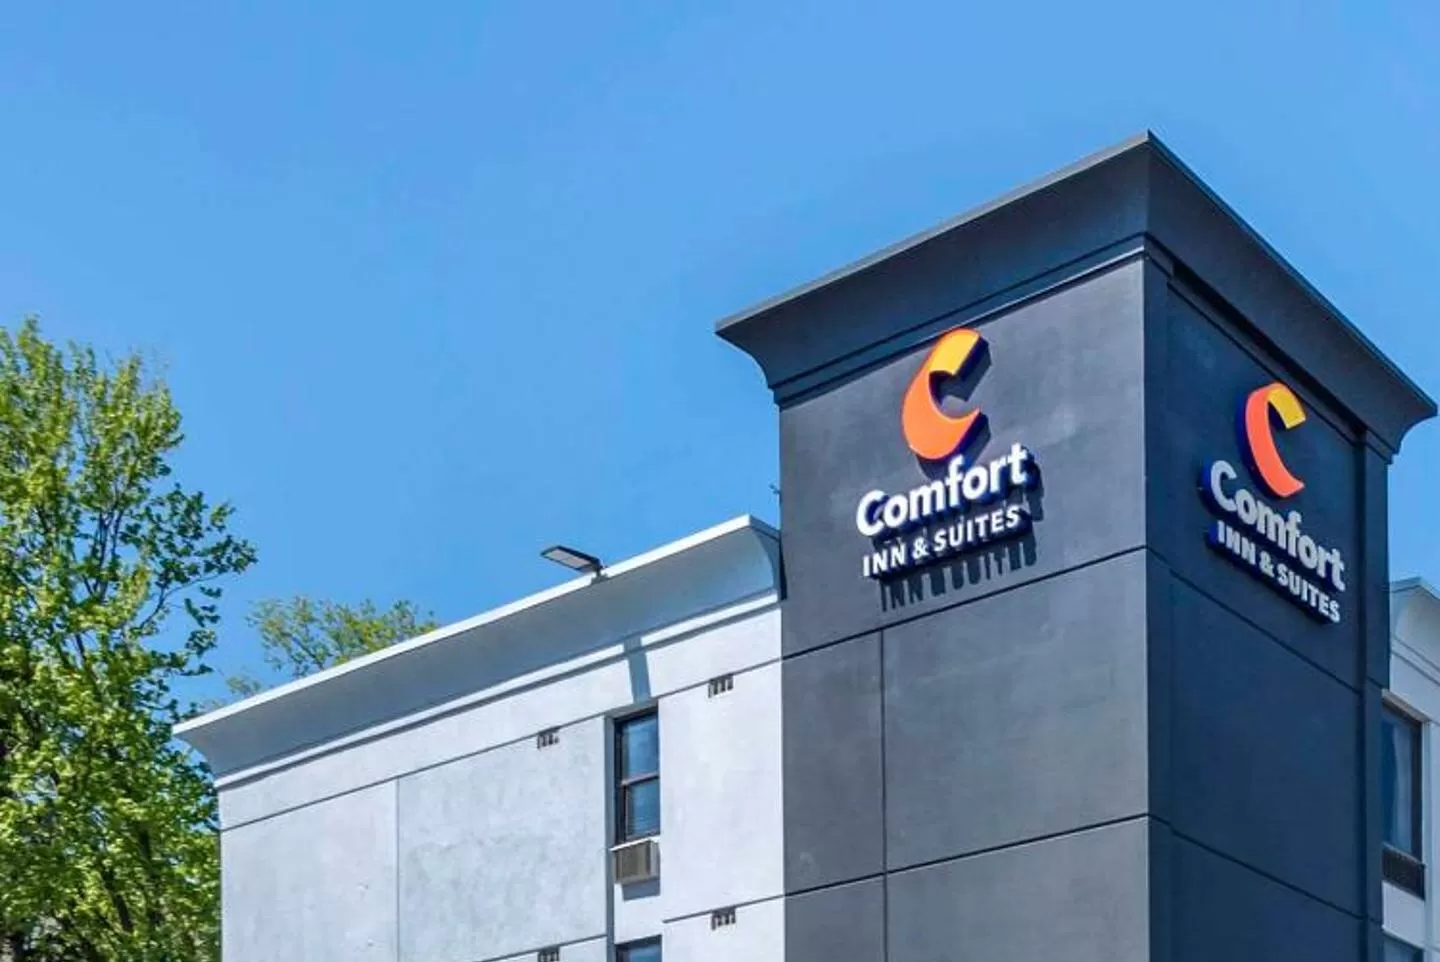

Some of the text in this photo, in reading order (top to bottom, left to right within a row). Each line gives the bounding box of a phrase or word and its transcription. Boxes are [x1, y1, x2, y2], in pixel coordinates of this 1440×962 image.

[856, 443, 1027, 536] Comfort
[1210, 459, 1346, 592] Comfort
[863, 505, 1021, 577] INN & SUITES
[1217, 520, 1341, 623] INN & SUITES
